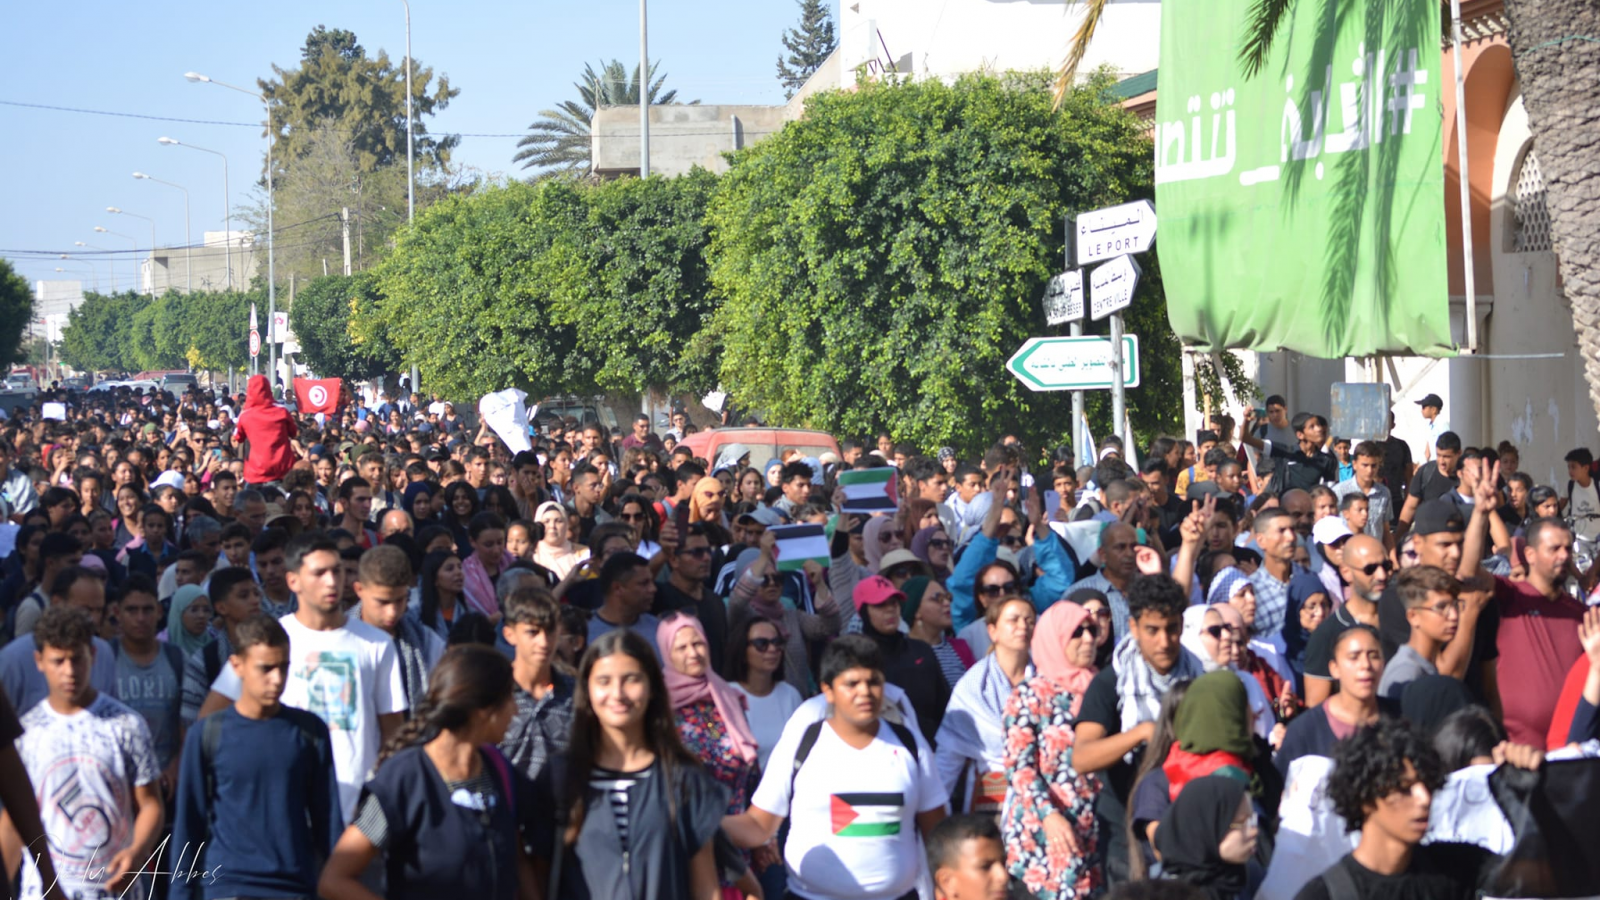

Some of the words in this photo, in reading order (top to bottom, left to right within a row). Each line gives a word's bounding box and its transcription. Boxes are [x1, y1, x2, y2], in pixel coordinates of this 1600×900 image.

[1081, 208, 1144, 237] الميناء
[1088, 243, 1101, 257] LE
[1107, 235, 1139, 254] PORT
[1093, 294, 1113, 315] CENTRE
[1113, 288, 1128, 306] VILLE
